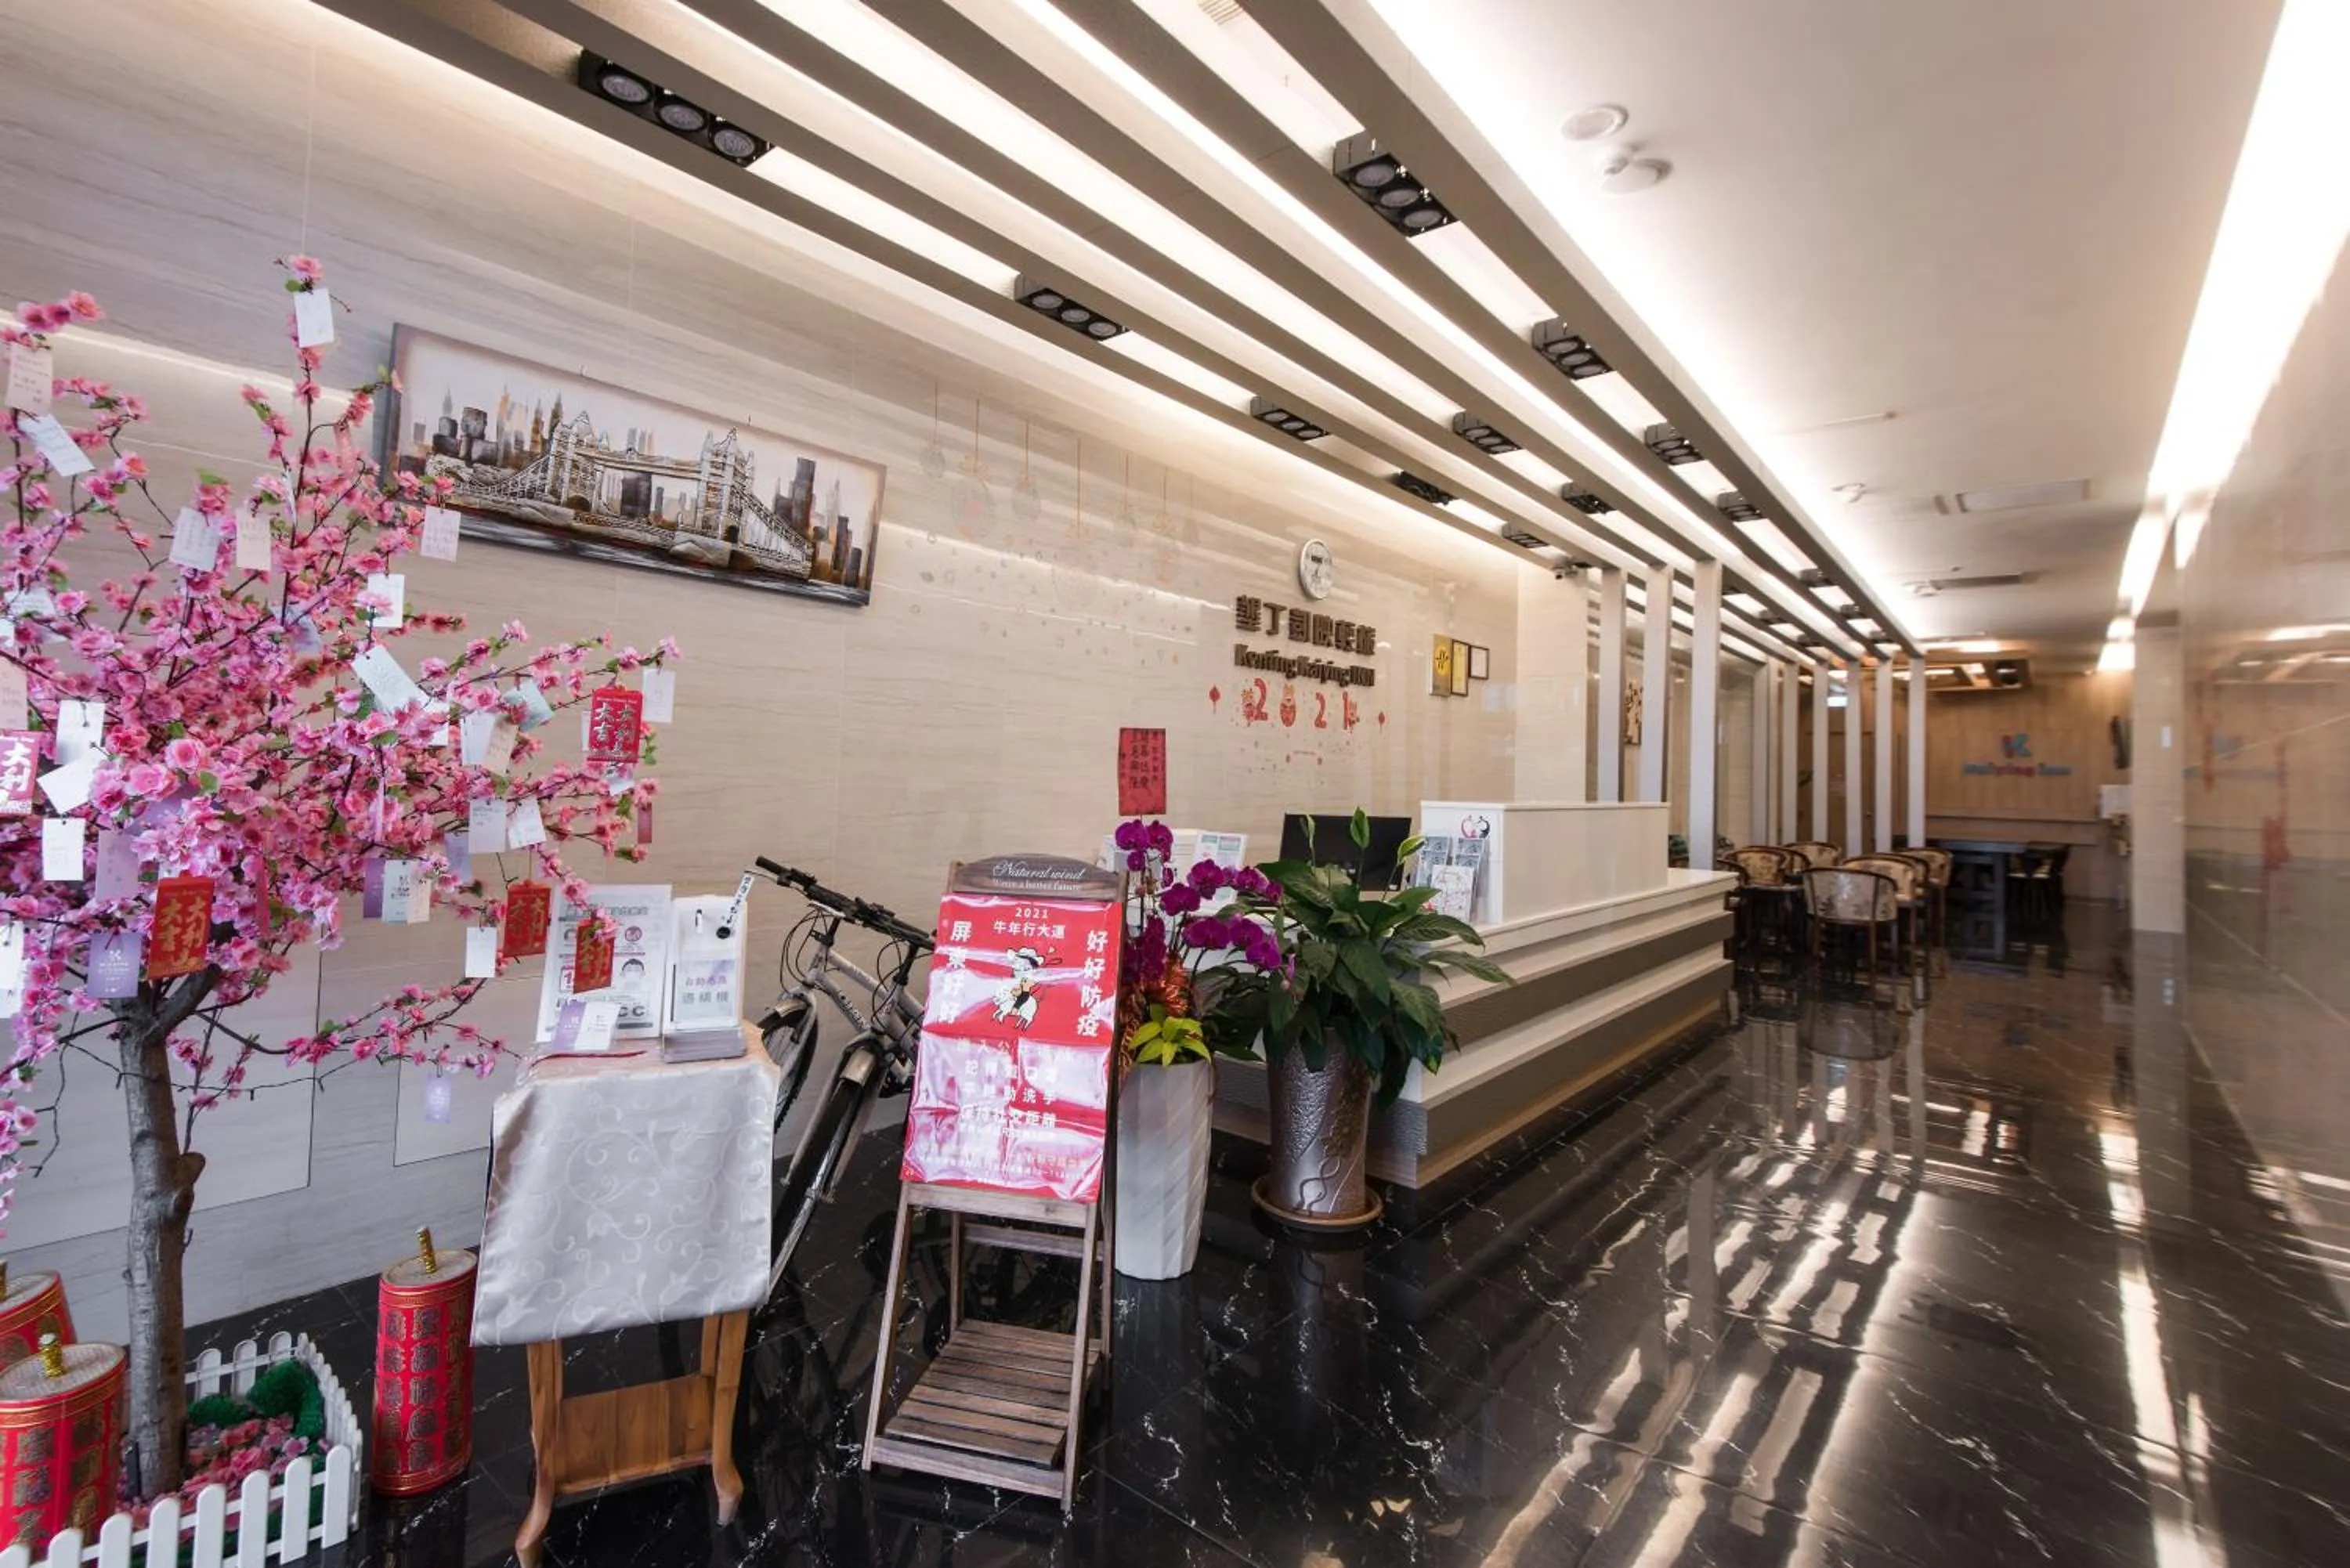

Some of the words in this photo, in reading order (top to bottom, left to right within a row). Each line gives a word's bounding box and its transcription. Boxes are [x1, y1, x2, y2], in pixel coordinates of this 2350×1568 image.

[1014, 907, 1049, 919] 2021
[993, 919, 1066, 939] 牛年行大運
[1077, 930, 1108, 1038] 好好防疫
